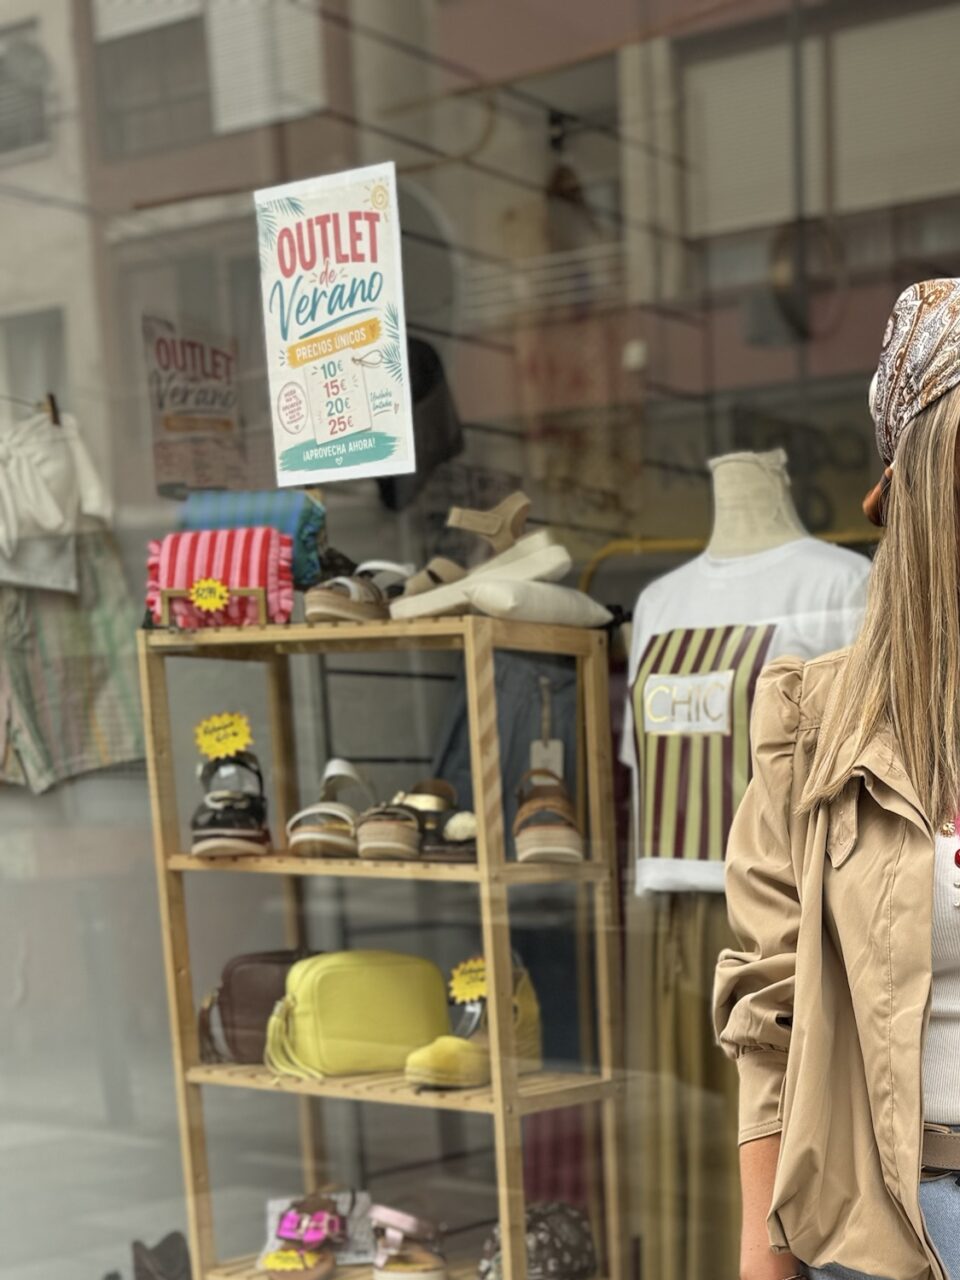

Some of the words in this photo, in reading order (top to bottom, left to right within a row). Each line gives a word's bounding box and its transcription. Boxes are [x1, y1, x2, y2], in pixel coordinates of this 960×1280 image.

[277, 211, 381, 278] OUTLET
[319, 257, 337, 287] de
[269, 271, 383, 341] Verano
[295, 339, 333, 361] PRECIOS
[335, 327, 367, 347] ÚNICOS
[155, 336, 236, 385] OUTLET
[320, 360, 344, 379] 10€
[323, 379, 347, 398] 15€
[326, 397, 351, 417] 20€
[328, 415, 354, 436] 25€
[303, 444, 347, 462] ¡APROVECHA
[348, 437, 376, 453] AHORA!
[645, 682, 725, 723] CHIC
